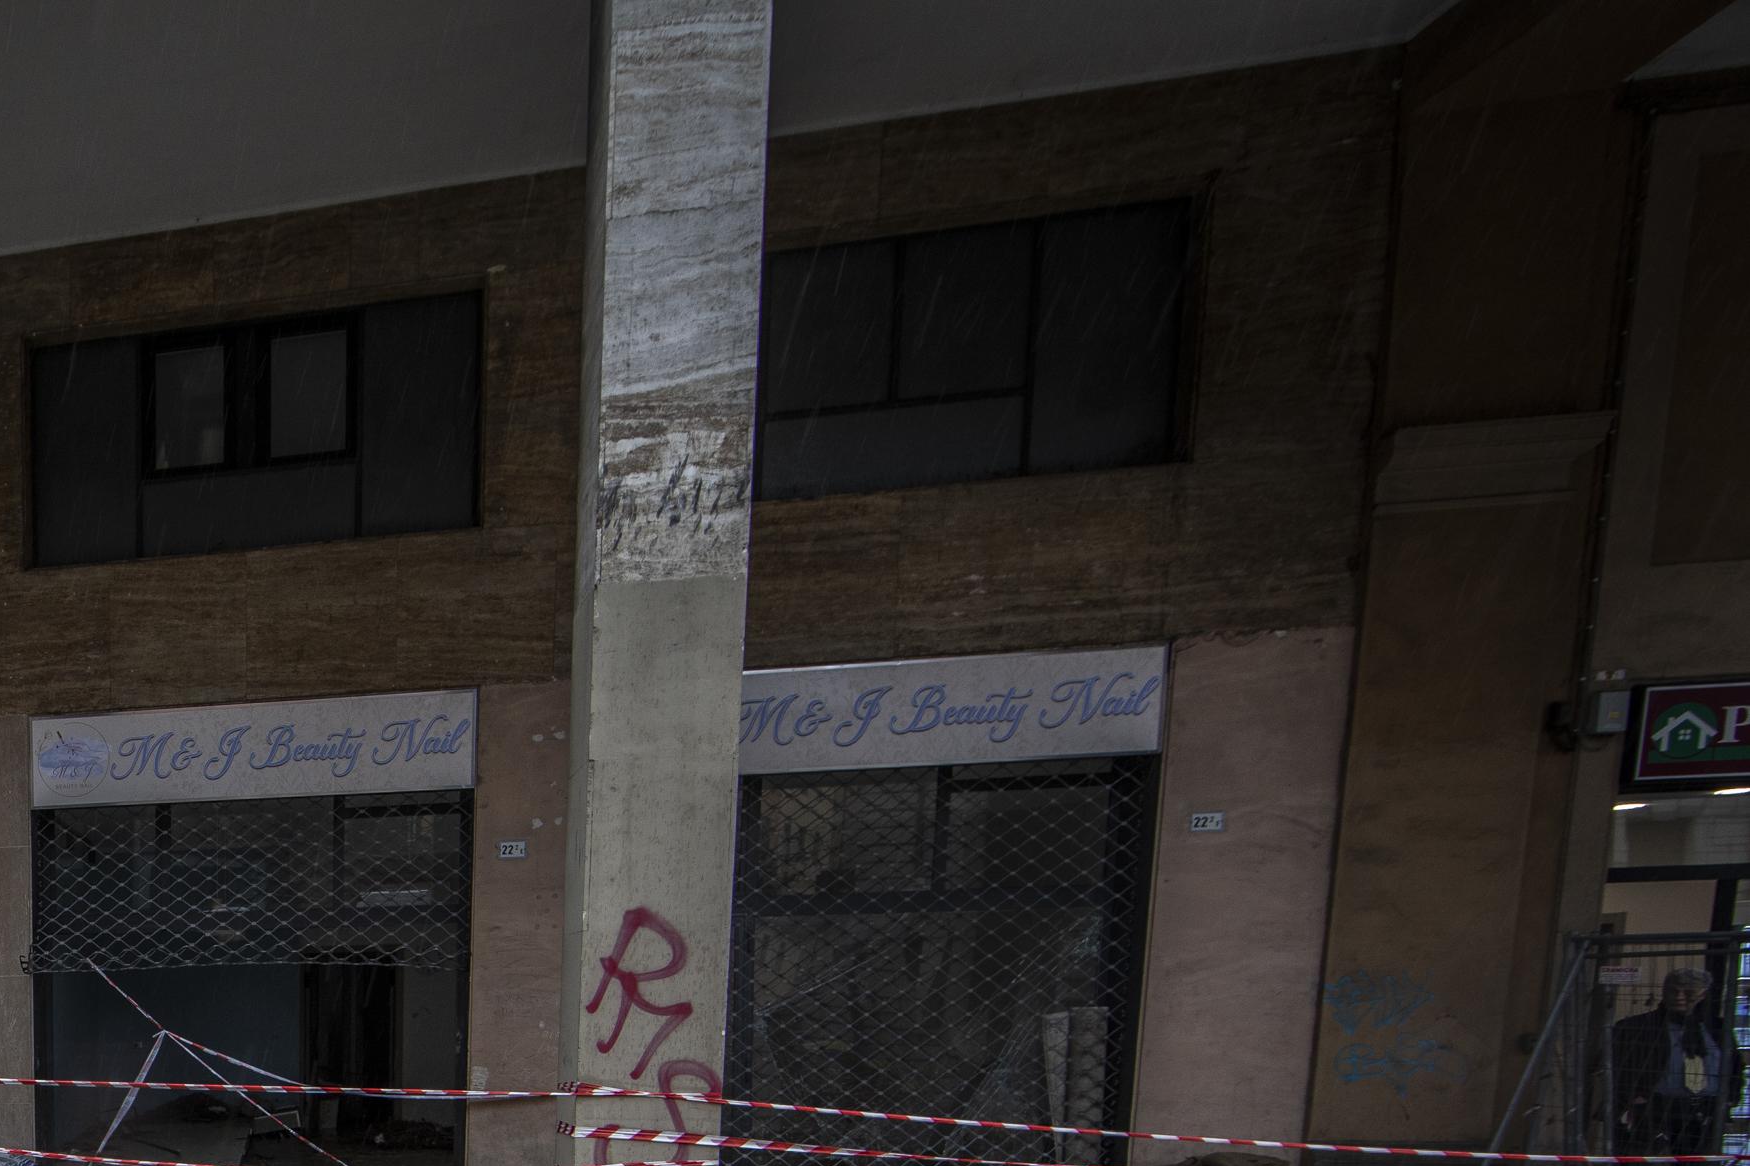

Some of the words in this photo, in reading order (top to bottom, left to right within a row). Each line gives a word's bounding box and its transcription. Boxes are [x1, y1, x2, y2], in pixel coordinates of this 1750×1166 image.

[794, 700, 832, 736] &
[889, 683, 1033, 743] Beauty
[1039, 671, 1161, 729] Nail
[110, 731, 175, 781] M
[170, 737, 202, 771] &
[251, 724, 366, 778] Beauty
[371, 713, 471, 765] Nail
